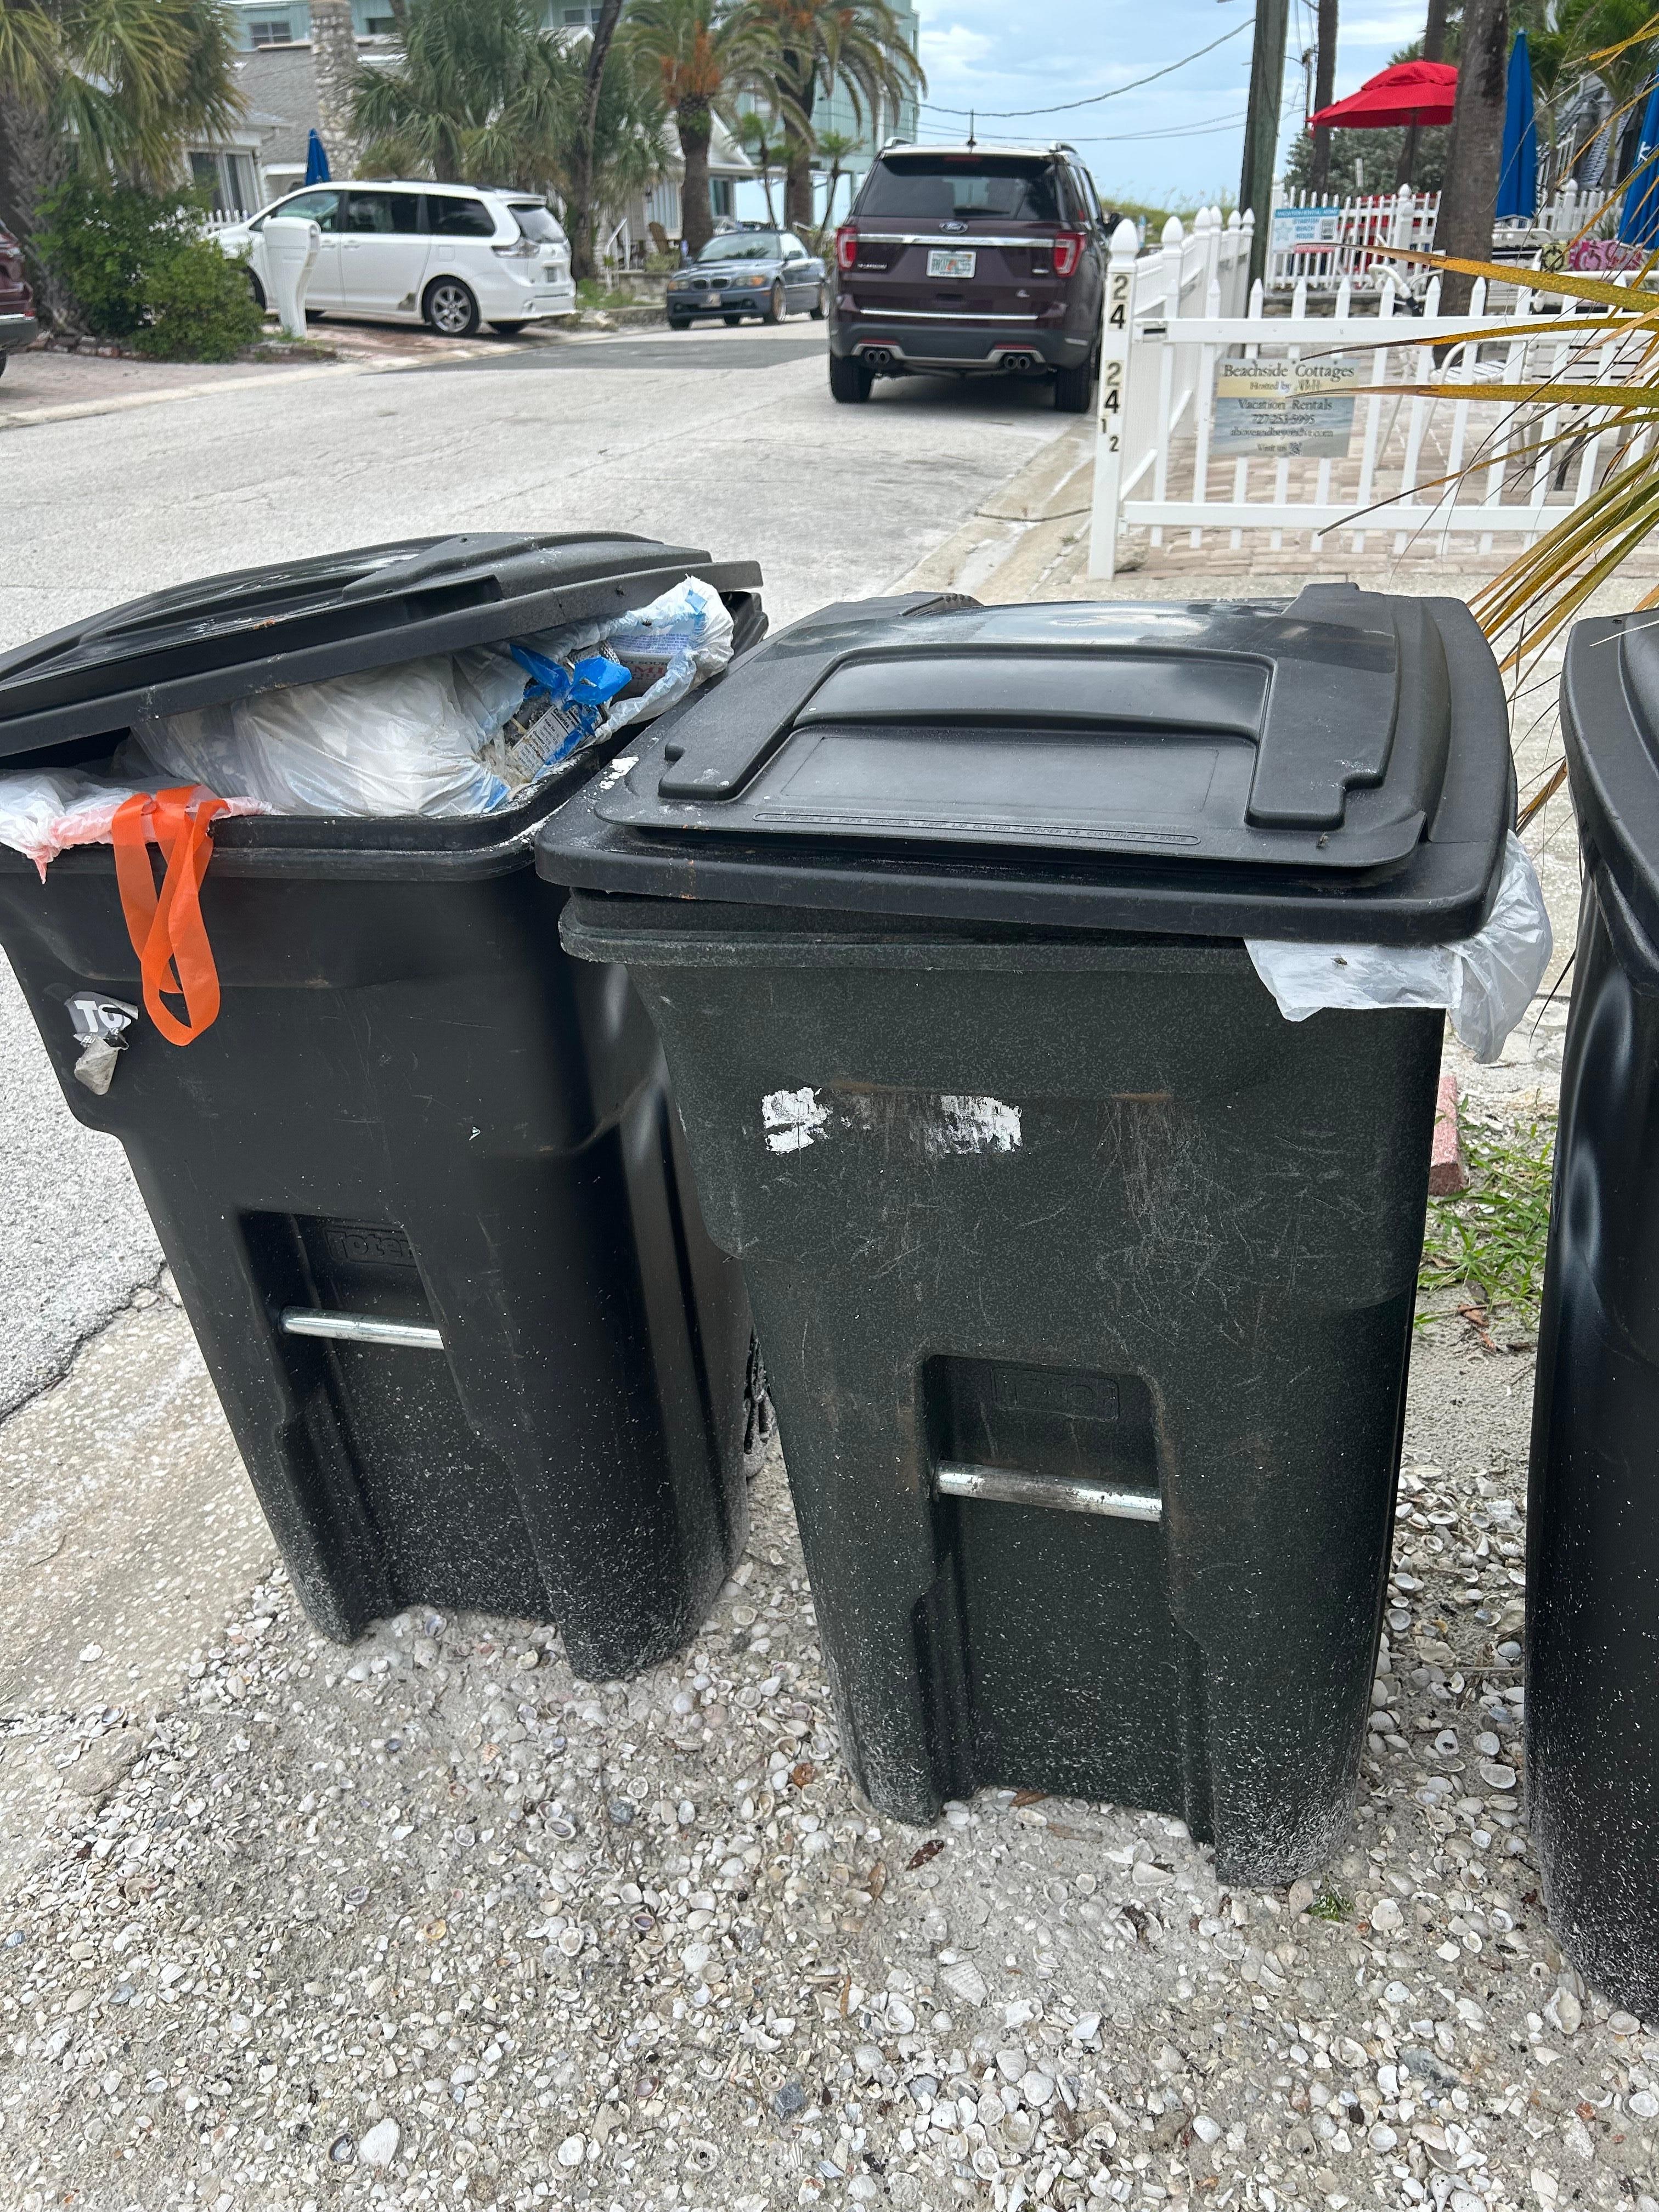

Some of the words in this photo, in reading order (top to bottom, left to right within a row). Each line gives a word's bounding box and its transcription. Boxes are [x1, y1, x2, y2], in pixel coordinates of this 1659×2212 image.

[1224, 363, 1289, 377] Beachside
[1295, 364, 1355, 382] Cottages
[1238, 398, 1286, 410] Vacation
[1291, 398, 1333, 410] Rentals
[553, 708, 570, 729] Calories
